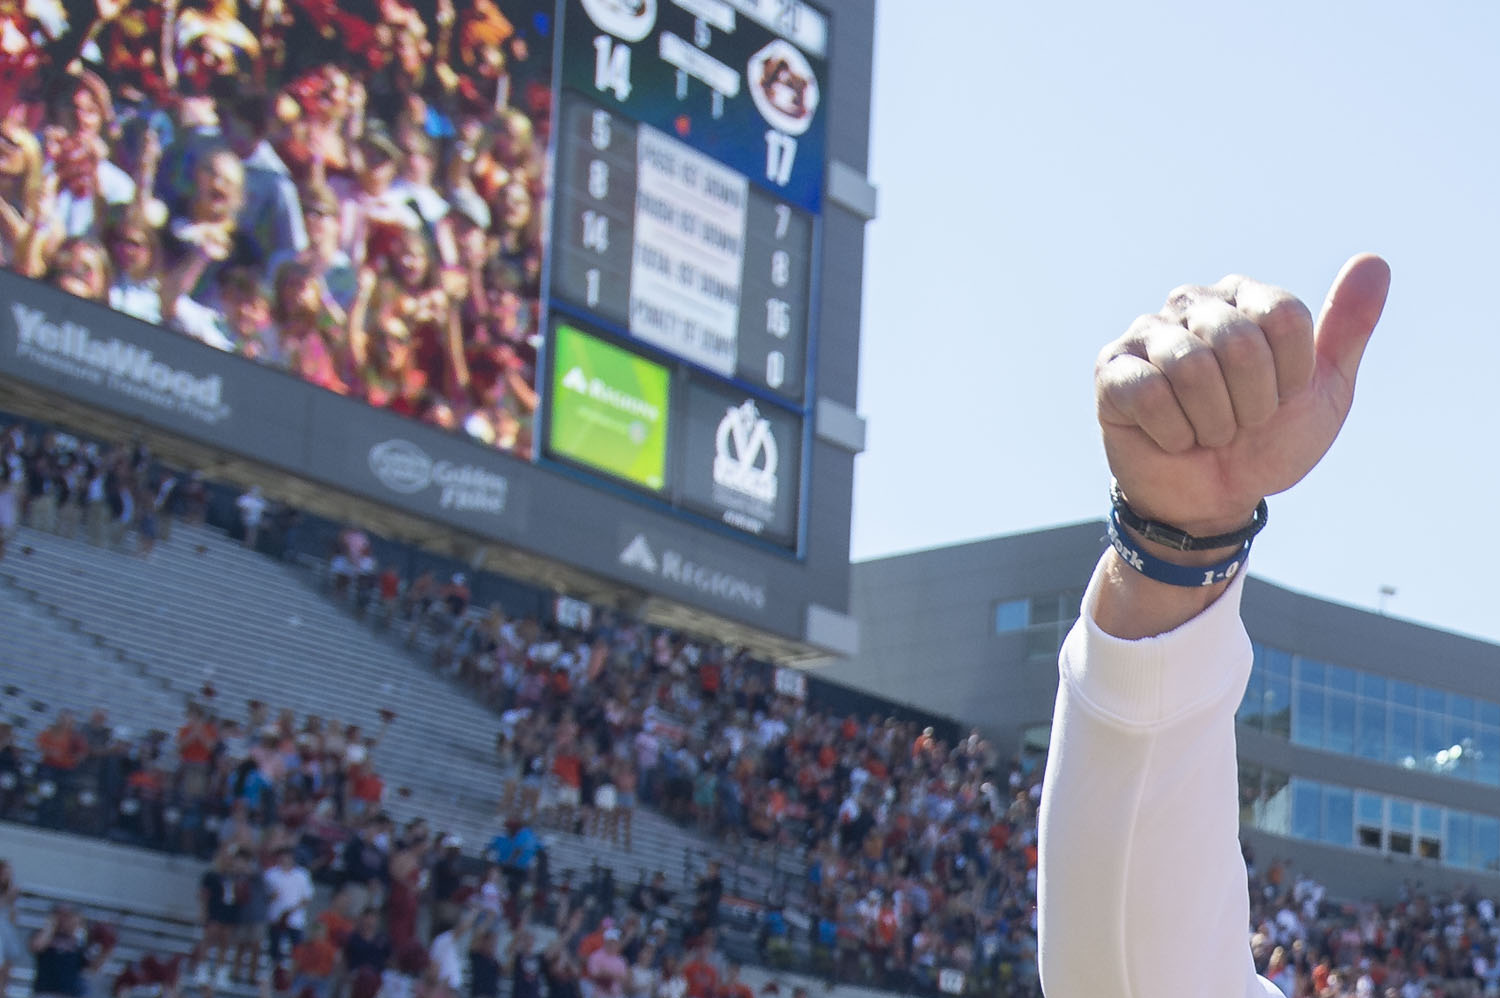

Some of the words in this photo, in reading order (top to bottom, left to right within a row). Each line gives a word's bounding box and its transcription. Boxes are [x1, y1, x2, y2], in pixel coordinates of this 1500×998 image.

[593, 35, 632, 101] 14
[765, 129, 798, 187] 17
[582, 210, 609, 253] 14
[586, 268, 600, 308] 1
[10, 302, 223, 408] YellaWood
[662, 551, 766, 609] REGIONS
